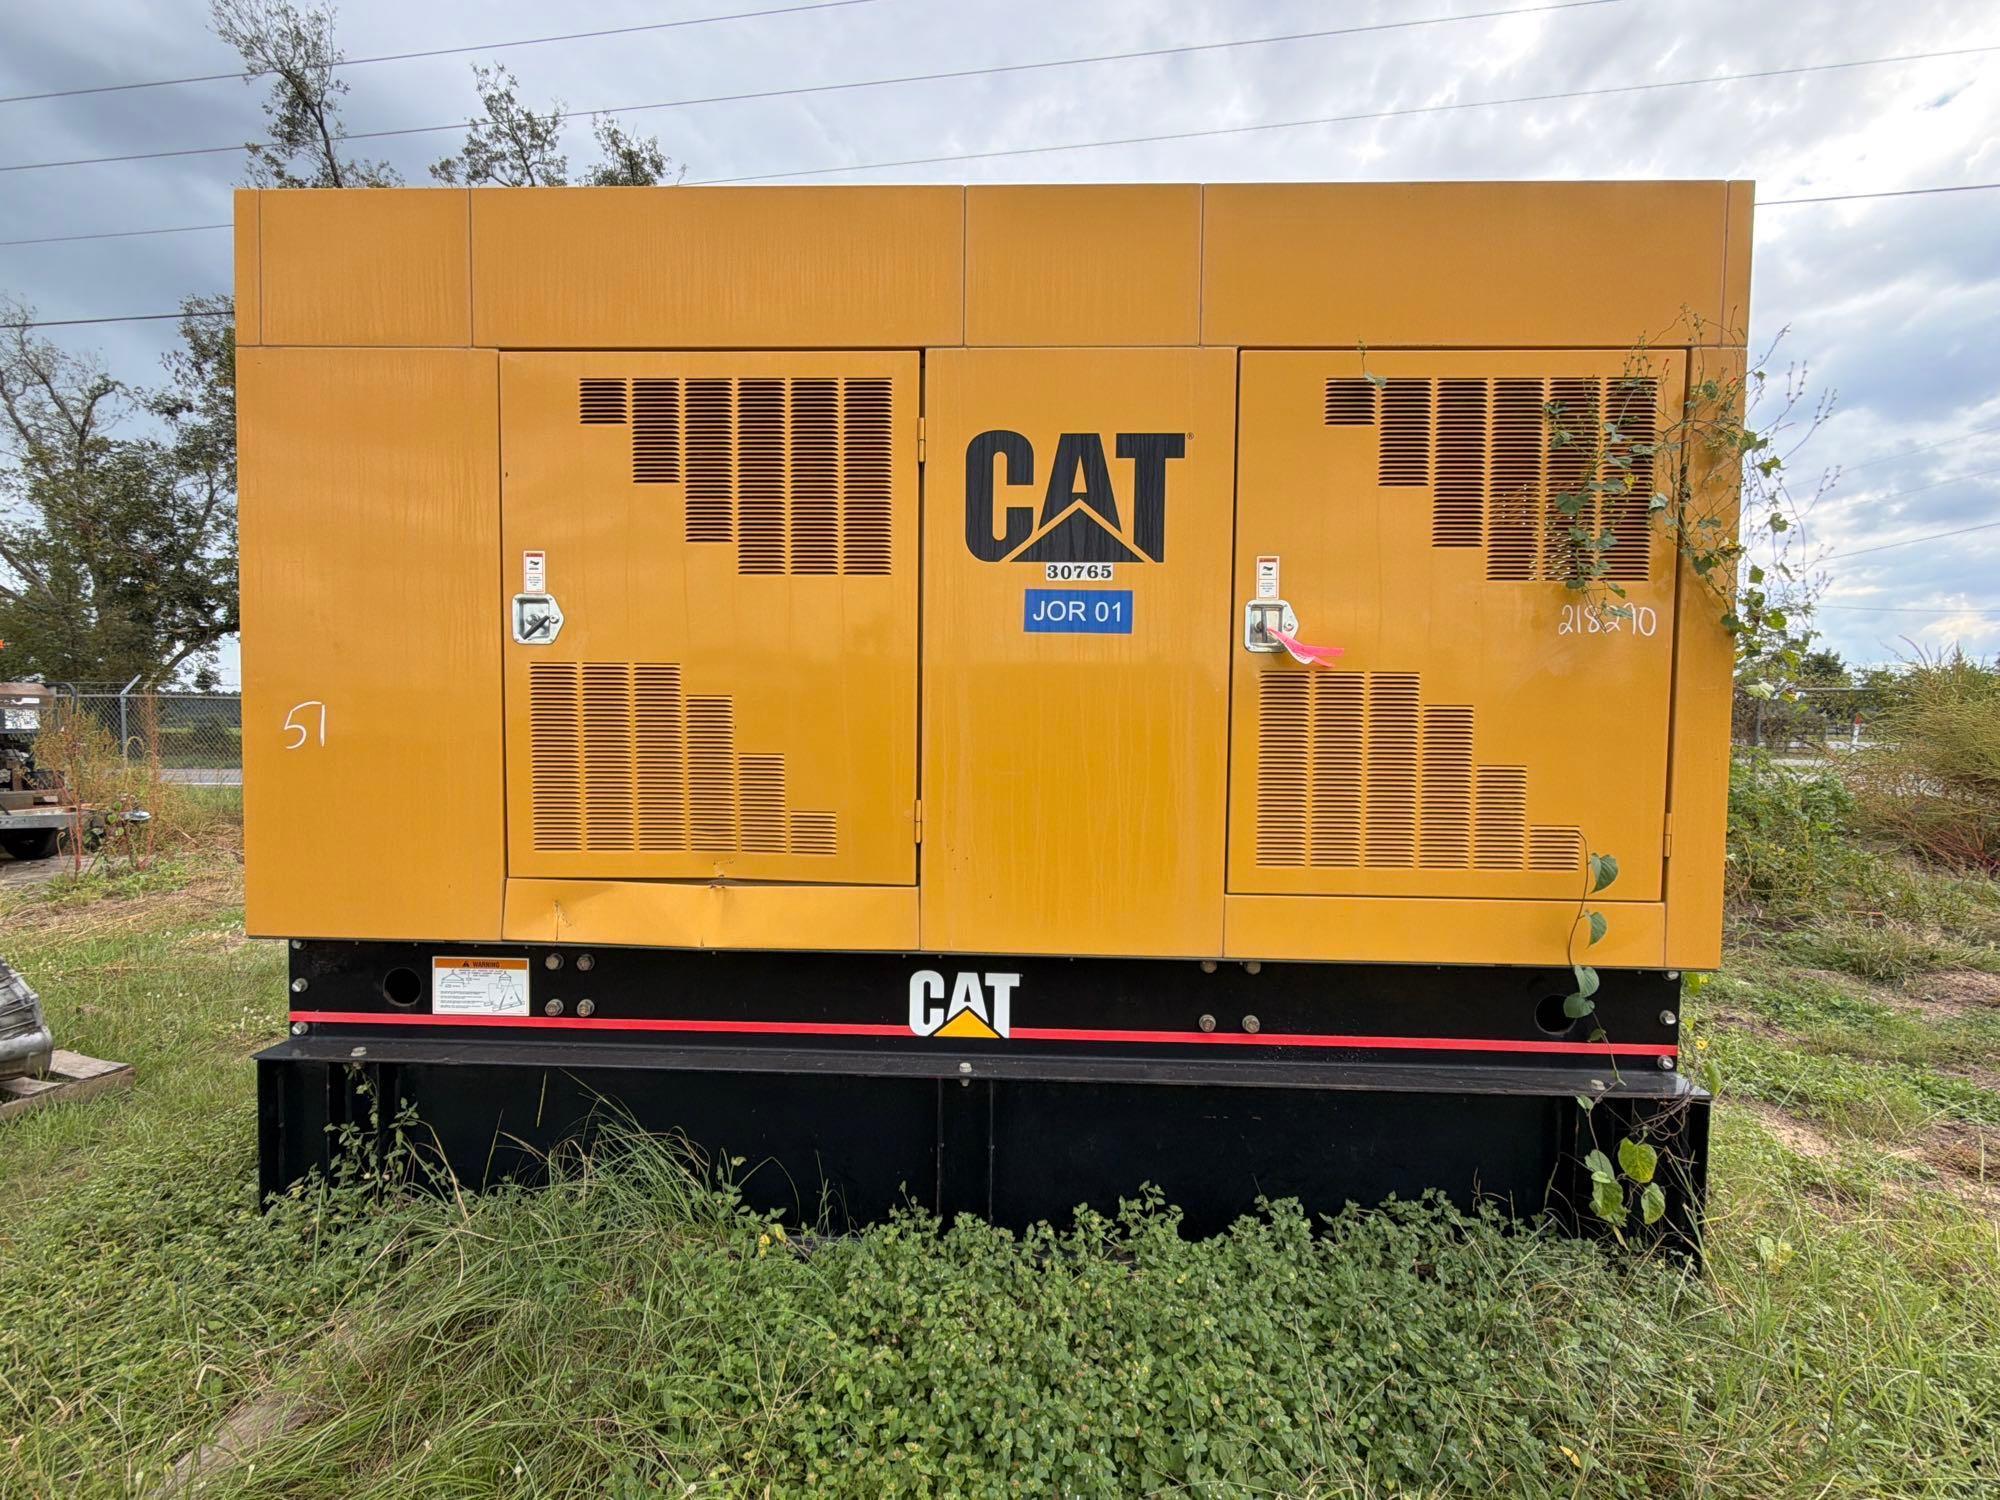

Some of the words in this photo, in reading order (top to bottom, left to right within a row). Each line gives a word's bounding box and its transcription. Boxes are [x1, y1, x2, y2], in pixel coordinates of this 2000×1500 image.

[965, 430, 1186, 563] CAT
[1046, 564, 1113, 580] 30765
[1032, 600, 1087, 622] JOR
[1094, 601, 1122, 623] 01
[283, 700, 326, 750] 51
[909, 969, 1020, 1039] CAT
